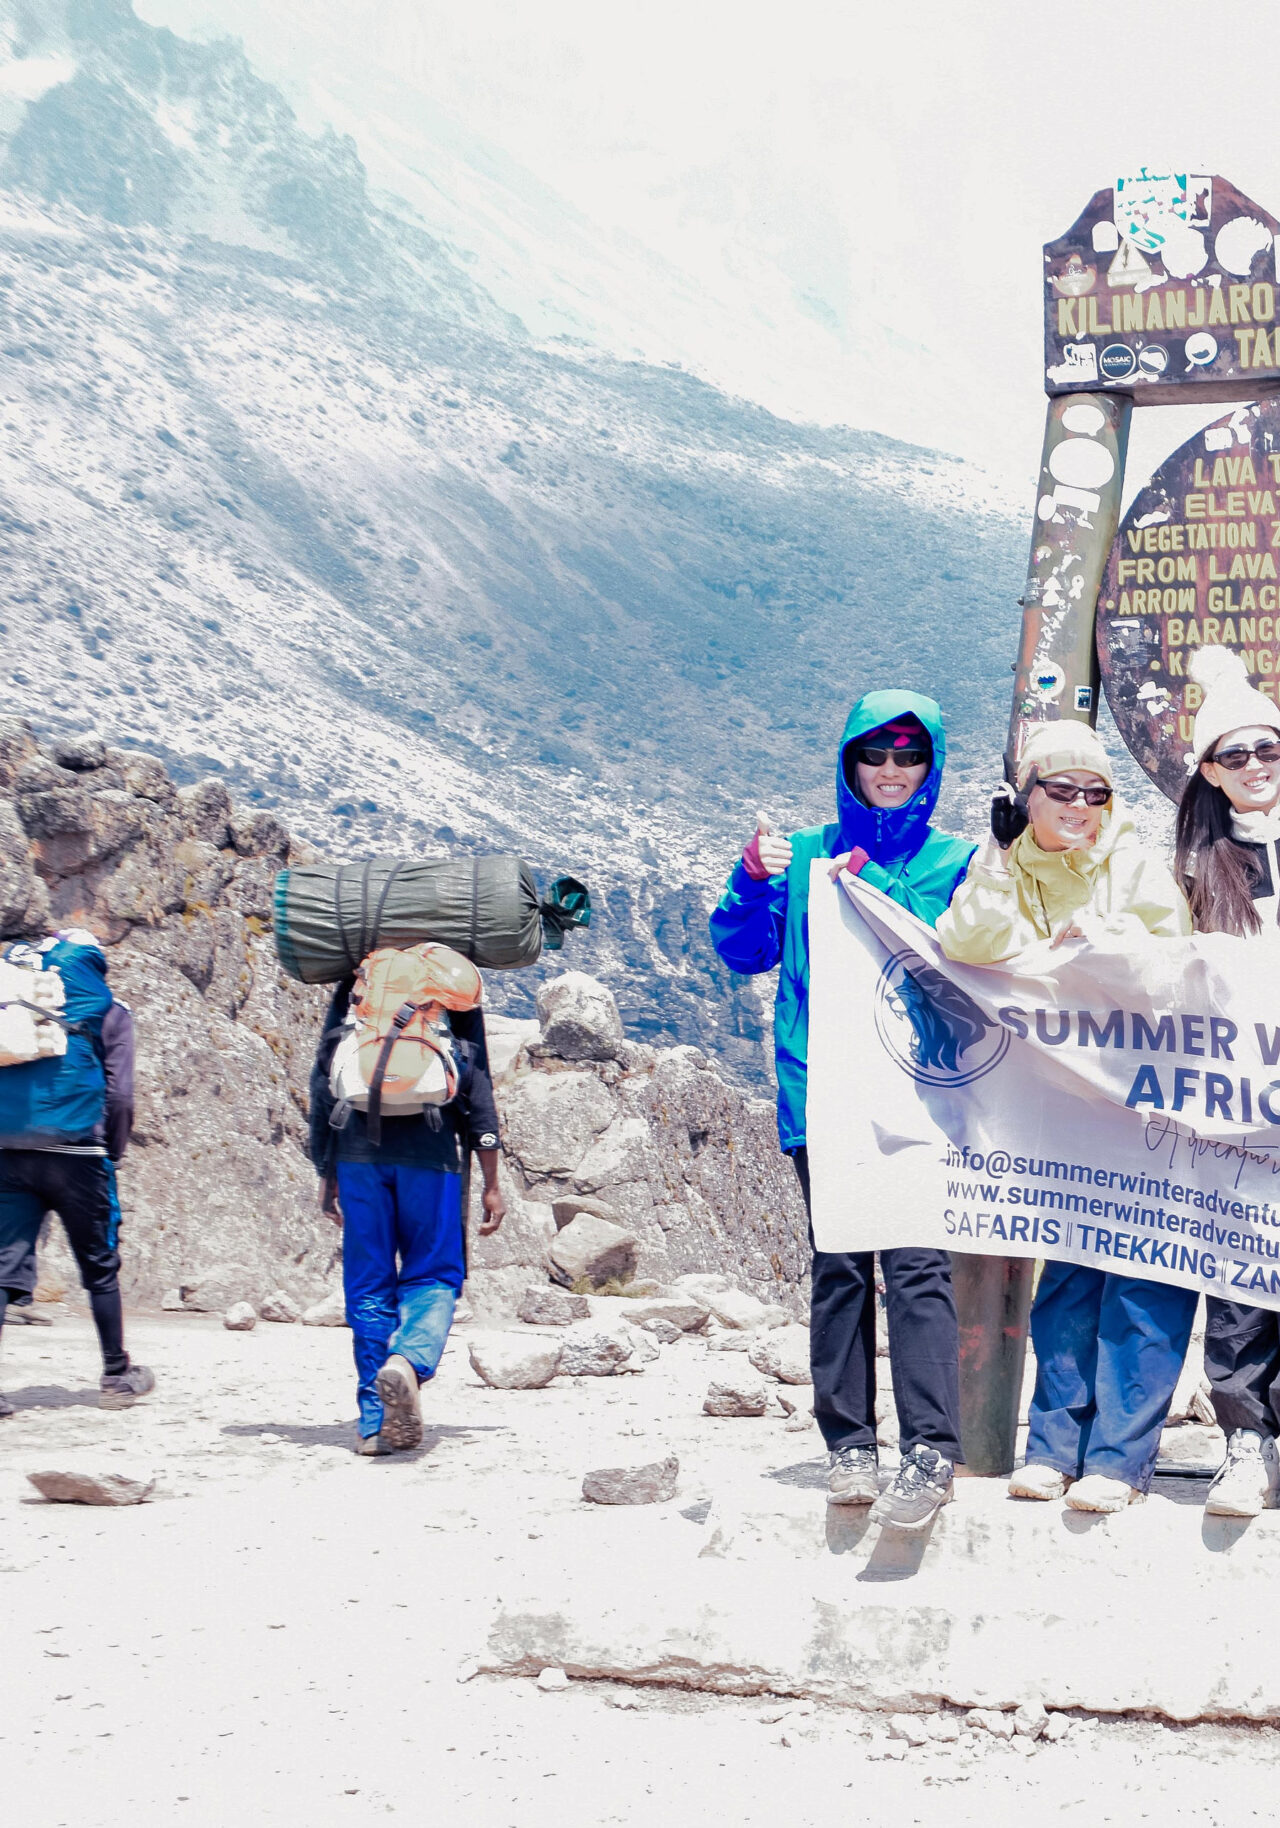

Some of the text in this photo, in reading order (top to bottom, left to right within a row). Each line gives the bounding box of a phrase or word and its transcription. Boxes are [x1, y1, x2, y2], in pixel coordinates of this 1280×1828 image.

[1058, 282, 1275, 336] KILIMANJARO
[1103, 355, 1131, 364] MOSAIC
[1194, 456, 1257, 488] LAVA
[1127, 521, 1257, 553] VEGETATION
[1118, 555, 1197, 586] FROM
[1209, 553, 1277, 581] LAVA
[1118, 587, 1196, 615] ARROW
[998, 1005, 1239, 1062] SUMMER
[943, 1208, 1061, 1245] SAFARIS
[1076, 1223, 1216, 1280] TREKKING
